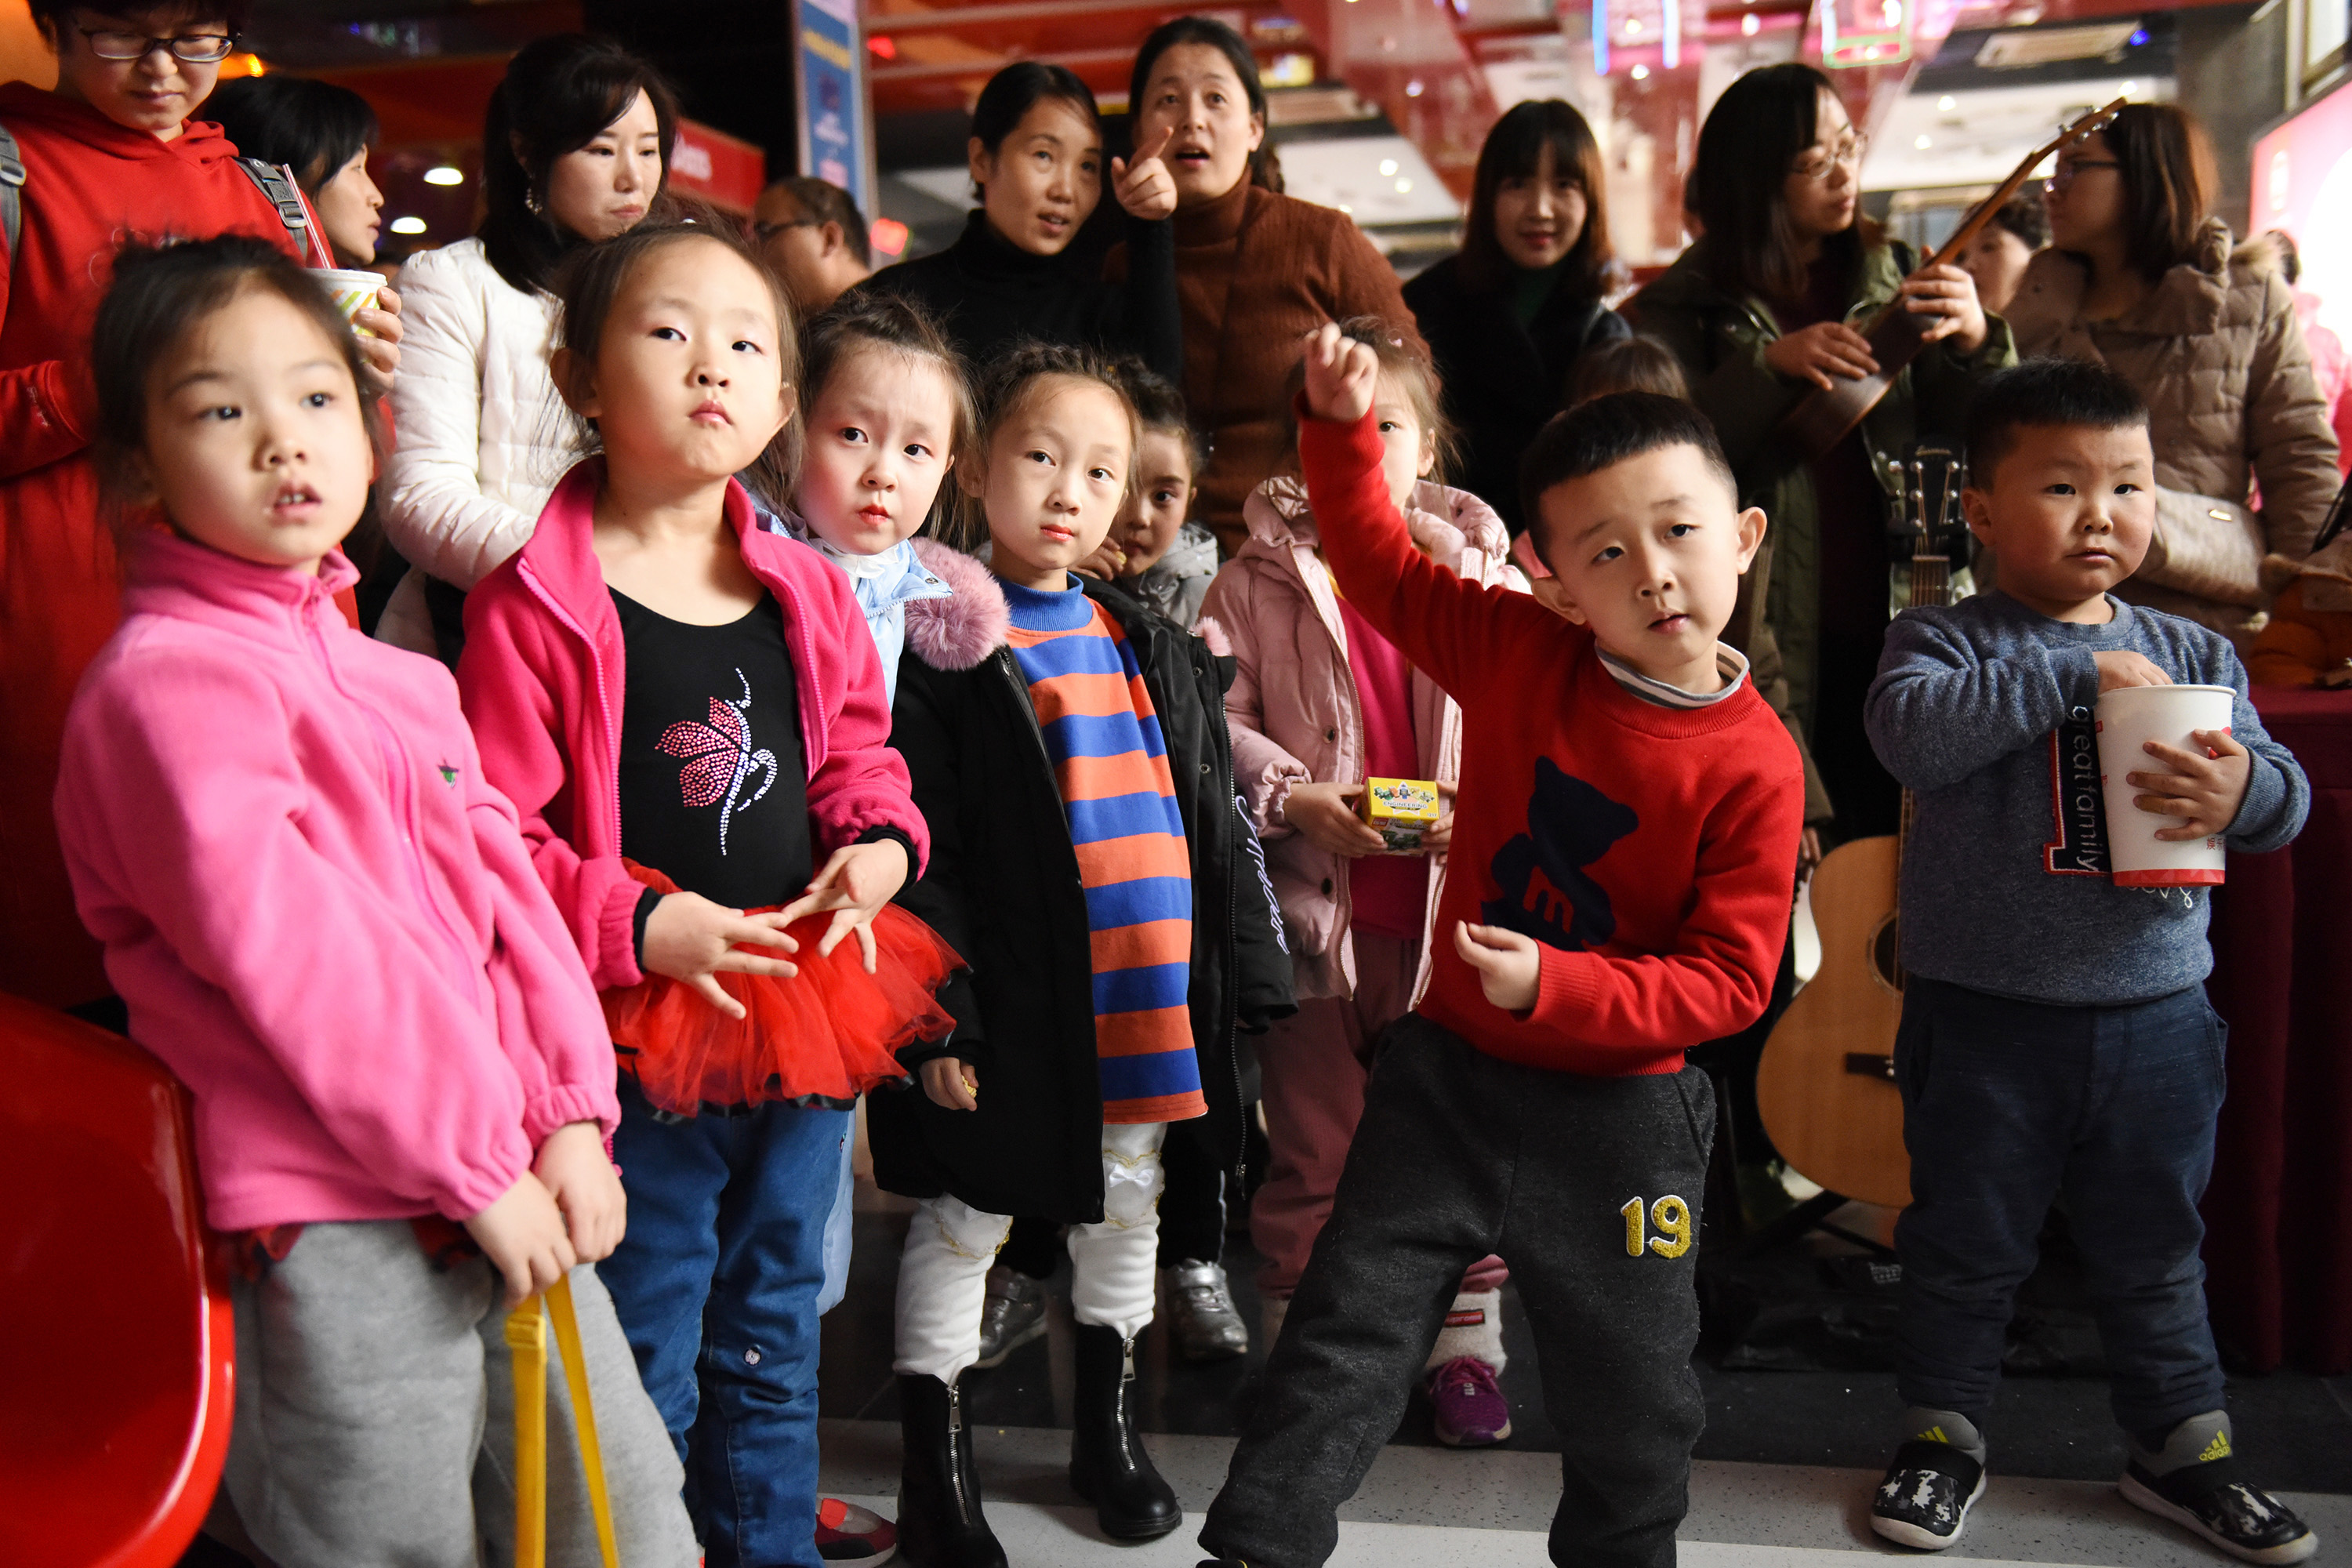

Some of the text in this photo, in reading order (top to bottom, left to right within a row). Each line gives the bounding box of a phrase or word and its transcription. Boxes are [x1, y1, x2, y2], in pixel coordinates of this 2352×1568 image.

[2067, 706, 2104, 871] great family
[1621, 1195, 1691, 1259] 19
[2198, 1444, 2230, 1461] adidas
